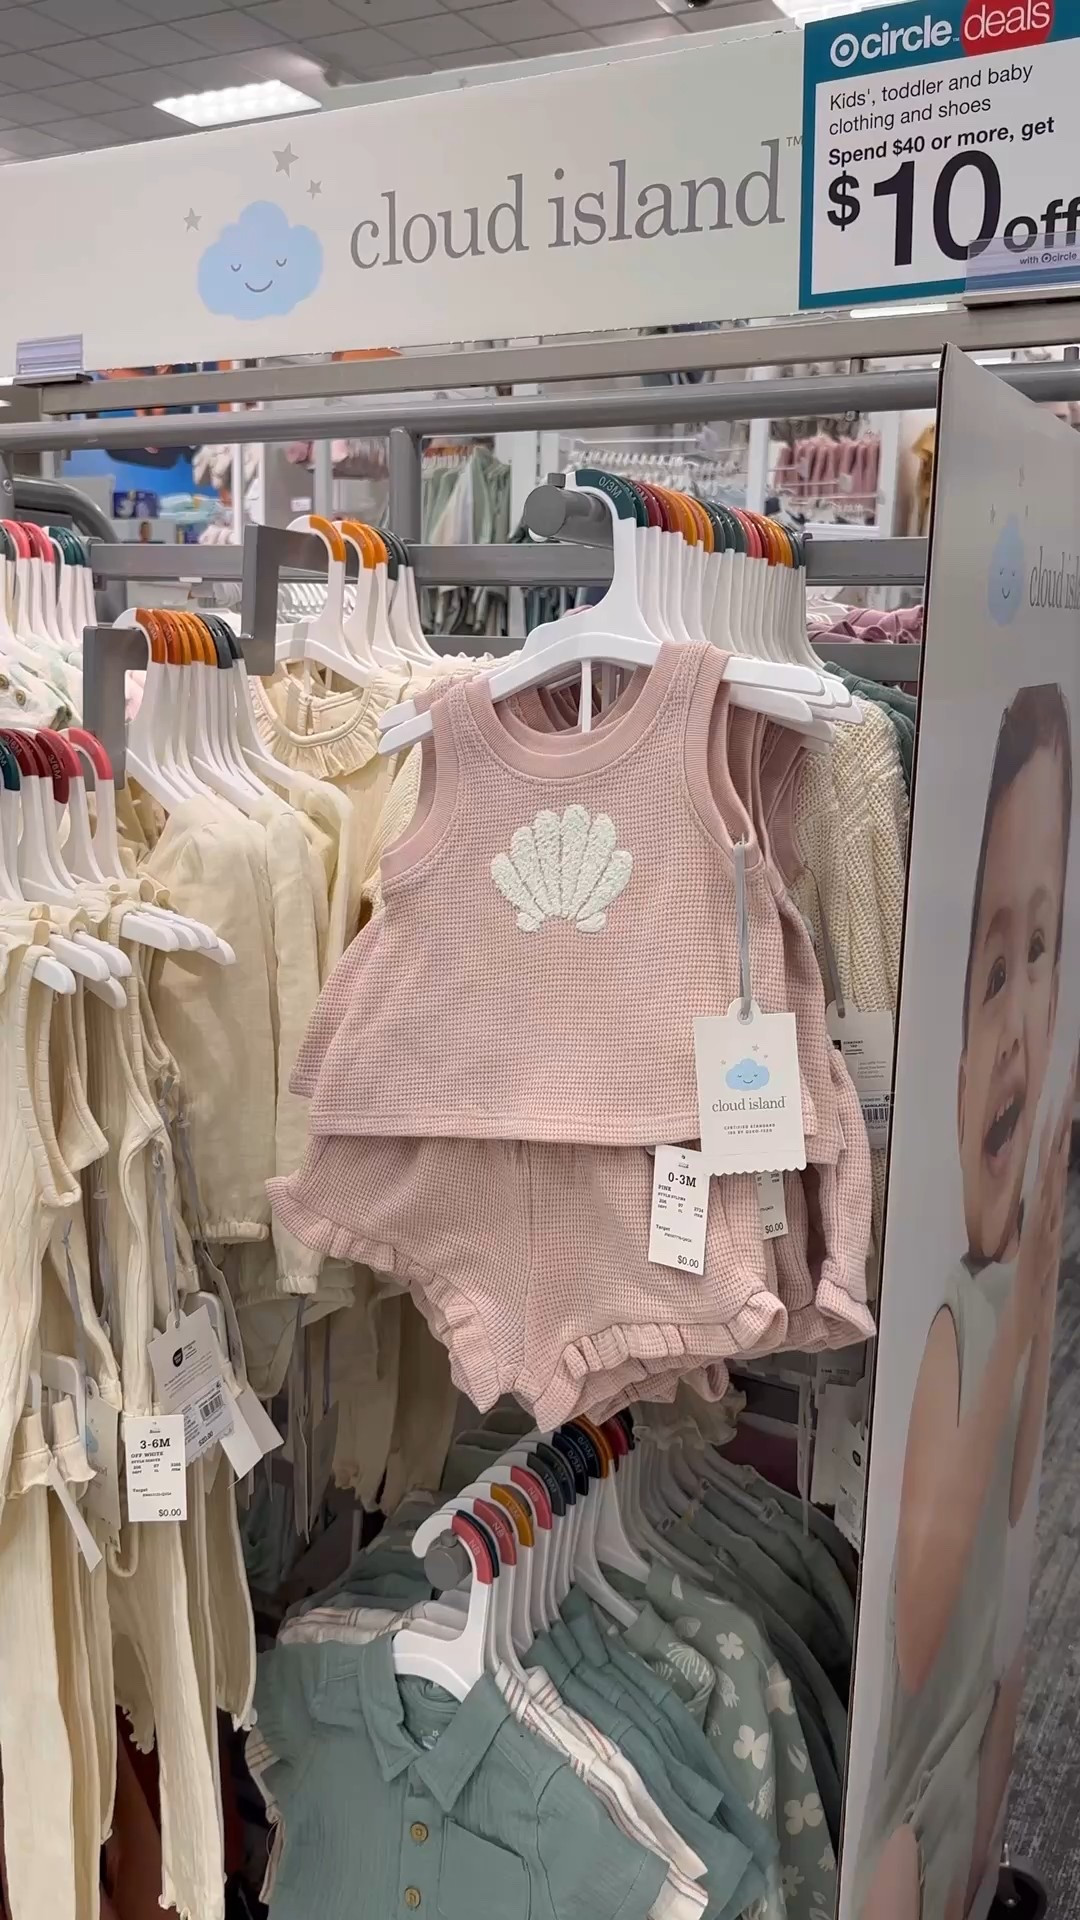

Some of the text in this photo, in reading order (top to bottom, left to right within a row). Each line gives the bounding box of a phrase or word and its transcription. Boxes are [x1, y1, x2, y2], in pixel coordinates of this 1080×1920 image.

[964, 0, 1051, 41] deals
[861, 15, 953, 59] circle
[830, 64, 1034, 111] Kids', toddler and baby
[829, 98, 991, 136] clothing and shoes
[828, 116, 1055, 168] Spend $40 or more, get
[350, 173, 530, 269] cloud
[547, 138, 786, 248] island
[1003, 197, 1080, 253] off
[1019, 252, 1078, 264] with circle
[598, 476, 622, 498] 0/3M
[1029, 545, 1080, 610] cloud isl
[712, 1095, 786, 1113] cloud island
[658, 1184, 672, 1192] PINK
[668, 1171, 697, 1188] 0-3M
[764, 1221, 784, 1234] $0.00
[677, 1255, 699, 1269] $0.00
[140, 1437, 171, 1450] 3-6M
[158, 1508, 182, 1517] $0.00
[468, 1539, 481, 1556] NB
